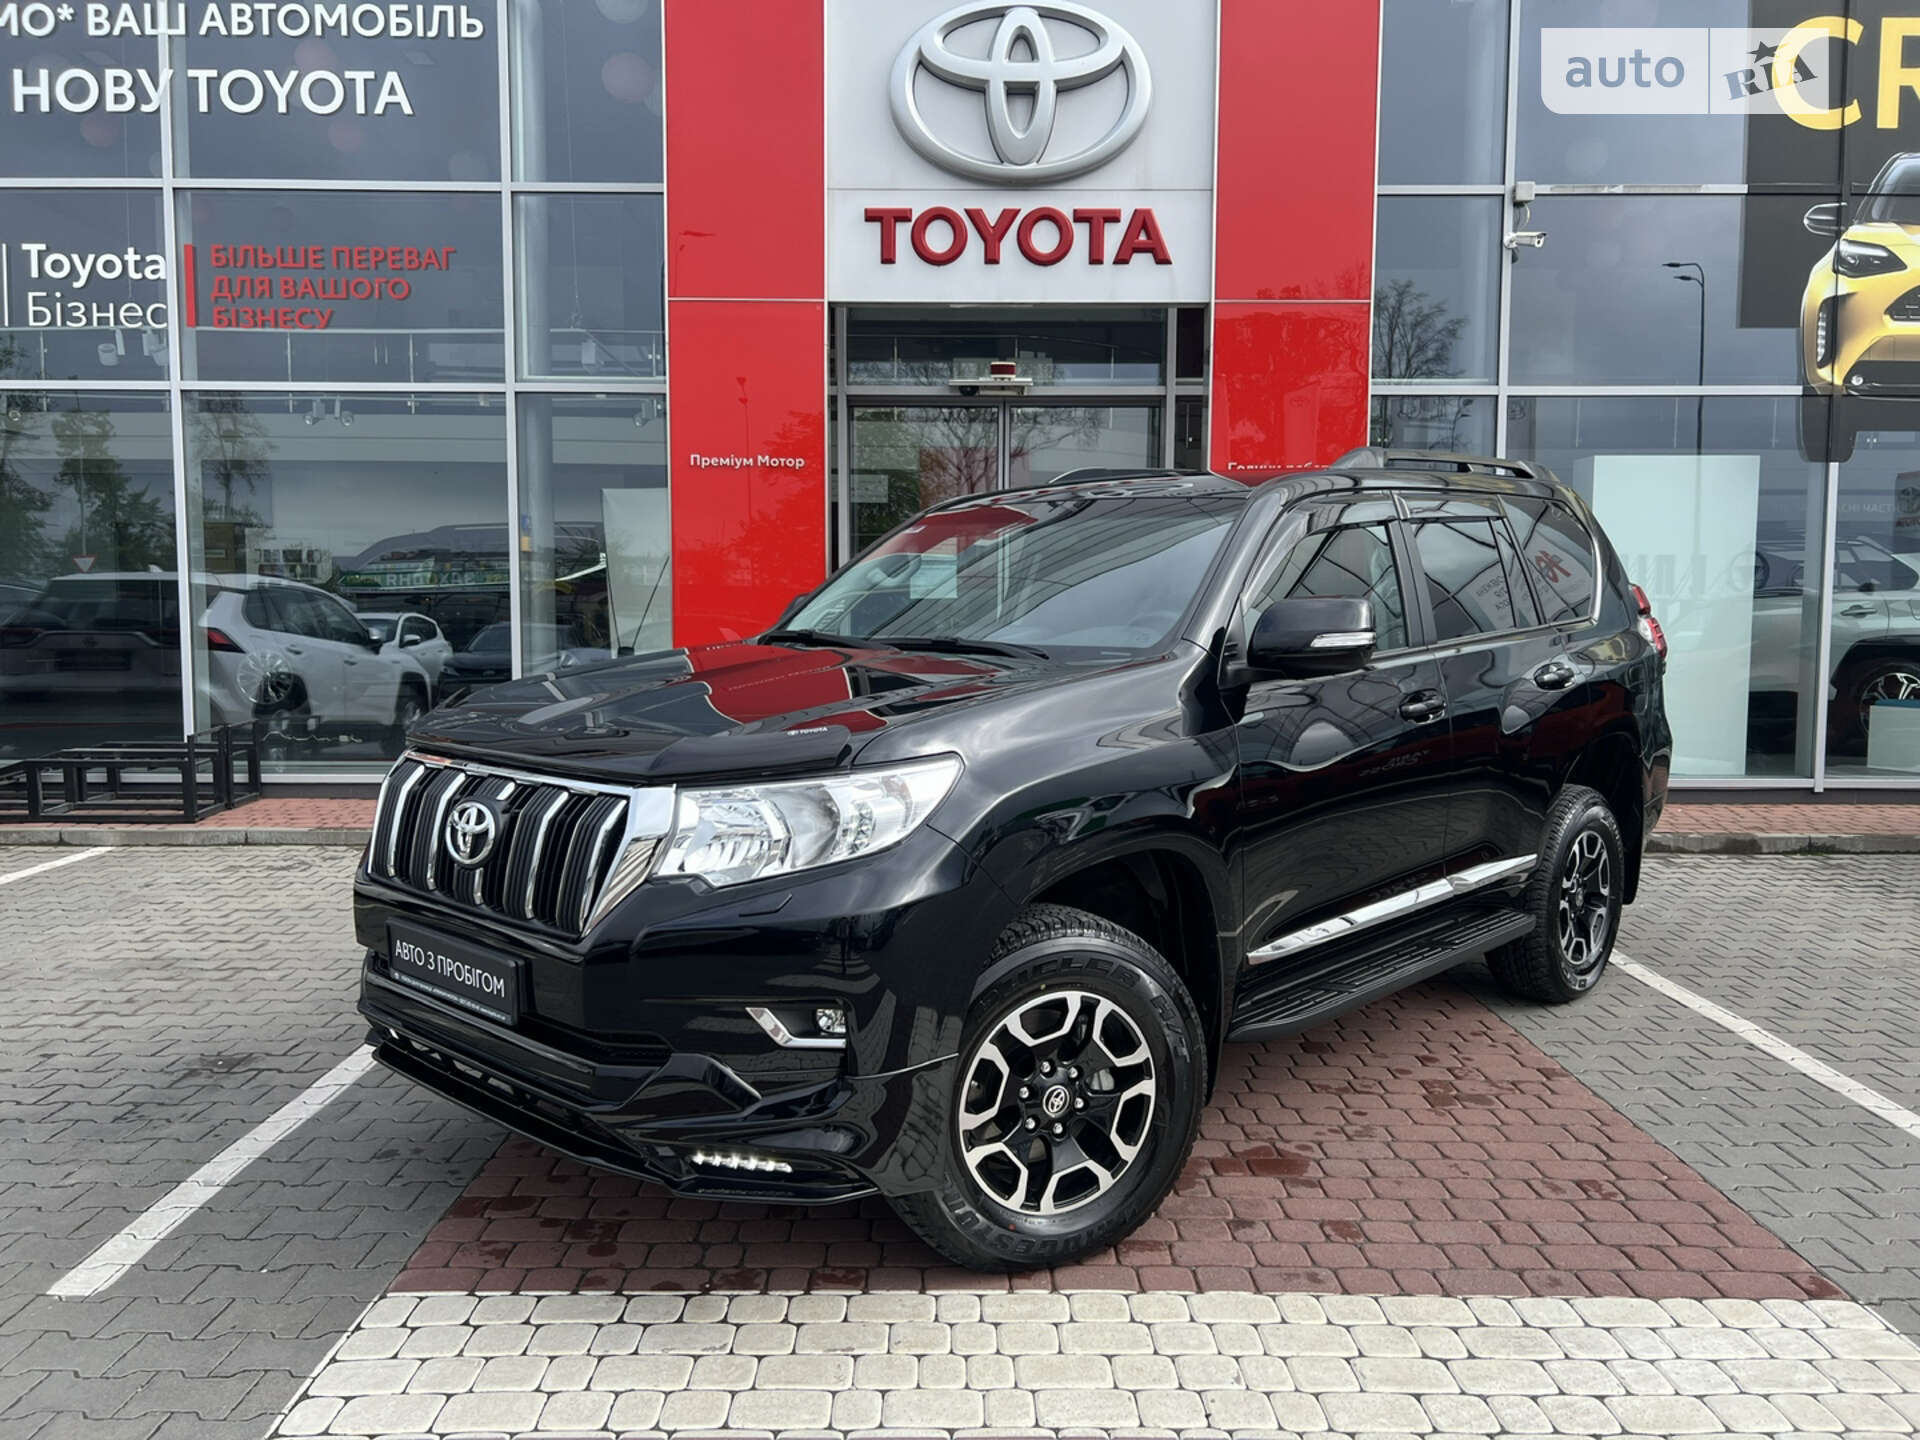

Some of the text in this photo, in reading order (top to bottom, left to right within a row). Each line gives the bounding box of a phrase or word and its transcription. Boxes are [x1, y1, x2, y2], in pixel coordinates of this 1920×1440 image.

[87, 3, 186, 36] ВАШ
[199, 3, 484, 39] АВТОМОБІЛЬ
[13, 68, 414, 115] НОВУ TOYOTA
[864, 206, 1173, 266] TOYOTA
[21, 243, 167, 288] Toyota
[210, 244, 456, 271] БІЛЬШЕ ПЕРЕВАГ
[210, 275, 411, 303] ДЛЯ ВАШОГО
[27, 291, 168, 328] Бізнес
[212, 306, 334, 330] БІЗНЕСУ
[690, 453, 806, 470] Преміум Мотор
[395, 939, 425, 967] АВТО
[427, 951, 435, 970] З
[437, 955, 506, 998] ПРОБІГОМ
